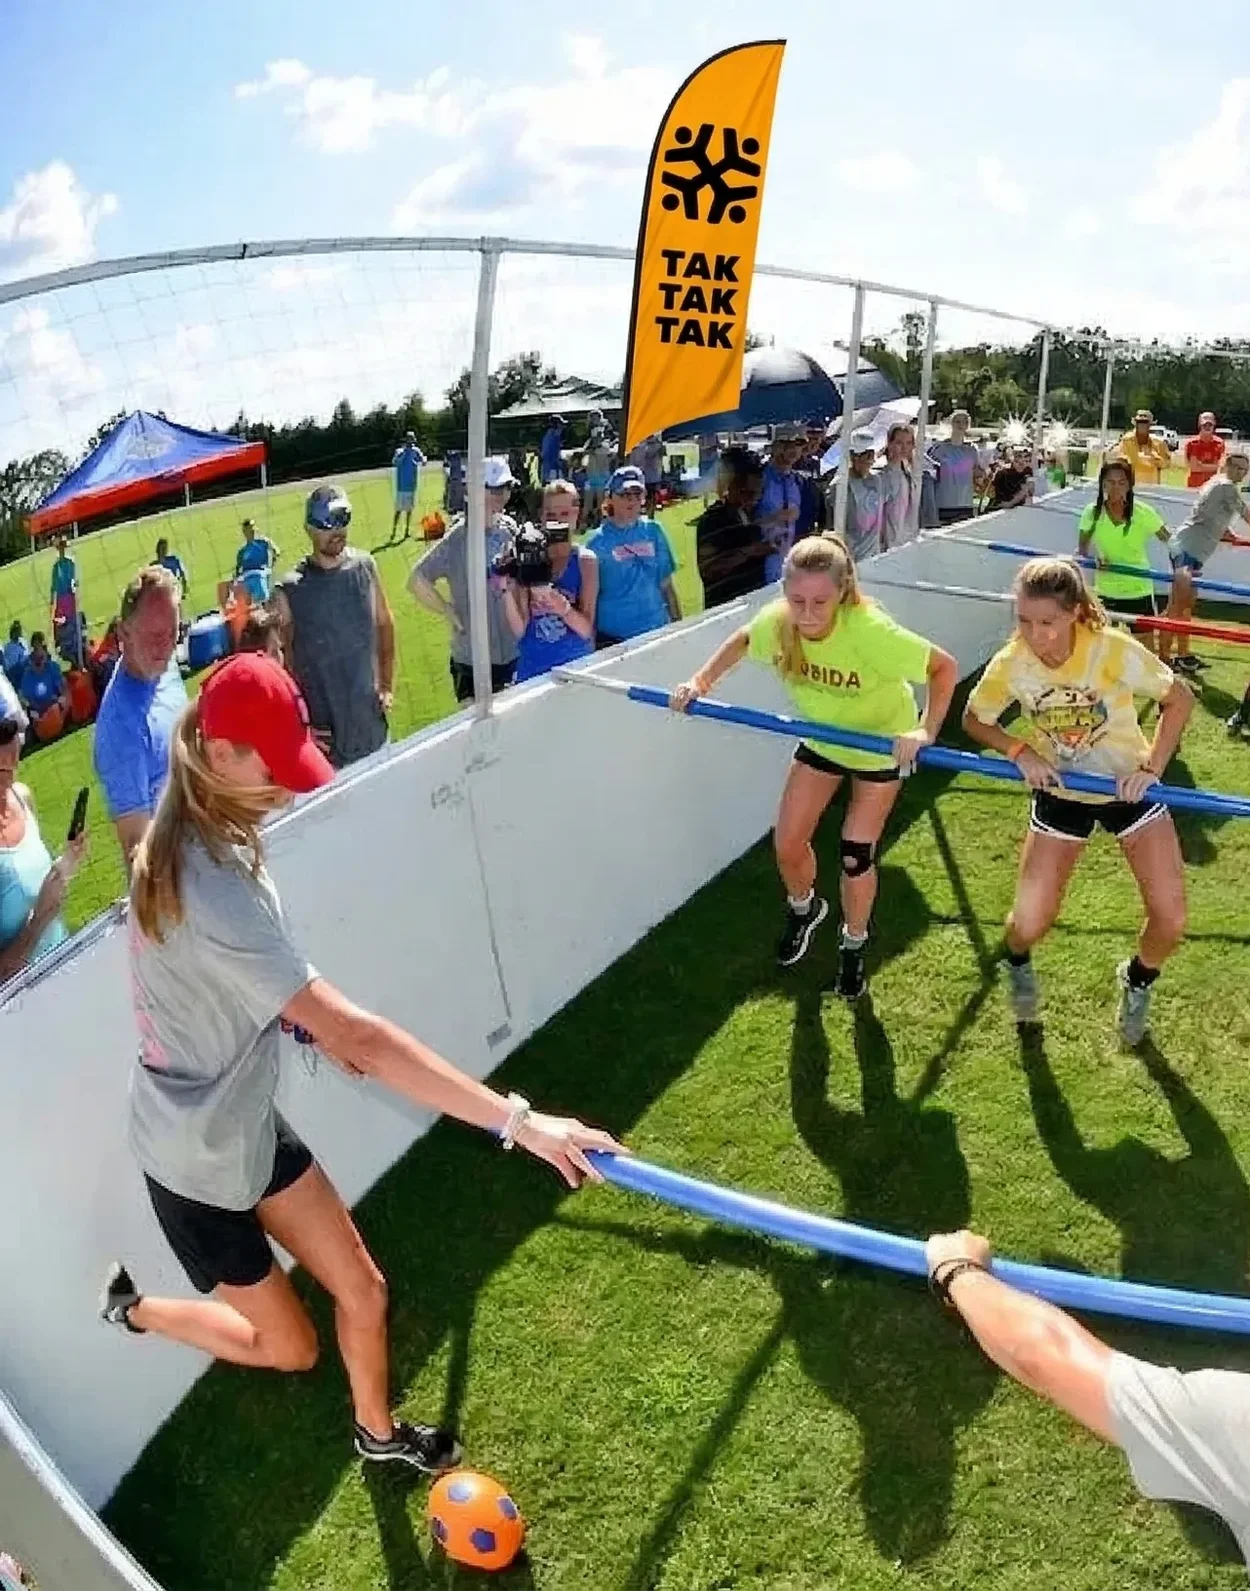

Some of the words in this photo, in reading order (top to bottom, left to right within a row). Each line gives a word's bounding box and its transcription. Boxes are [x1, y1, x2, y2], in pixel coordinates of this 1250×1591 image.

[661, 249, 740, 283] TAK
[658, 282, 738, 316] TAK
[655, 316, 734, 350] TAK
